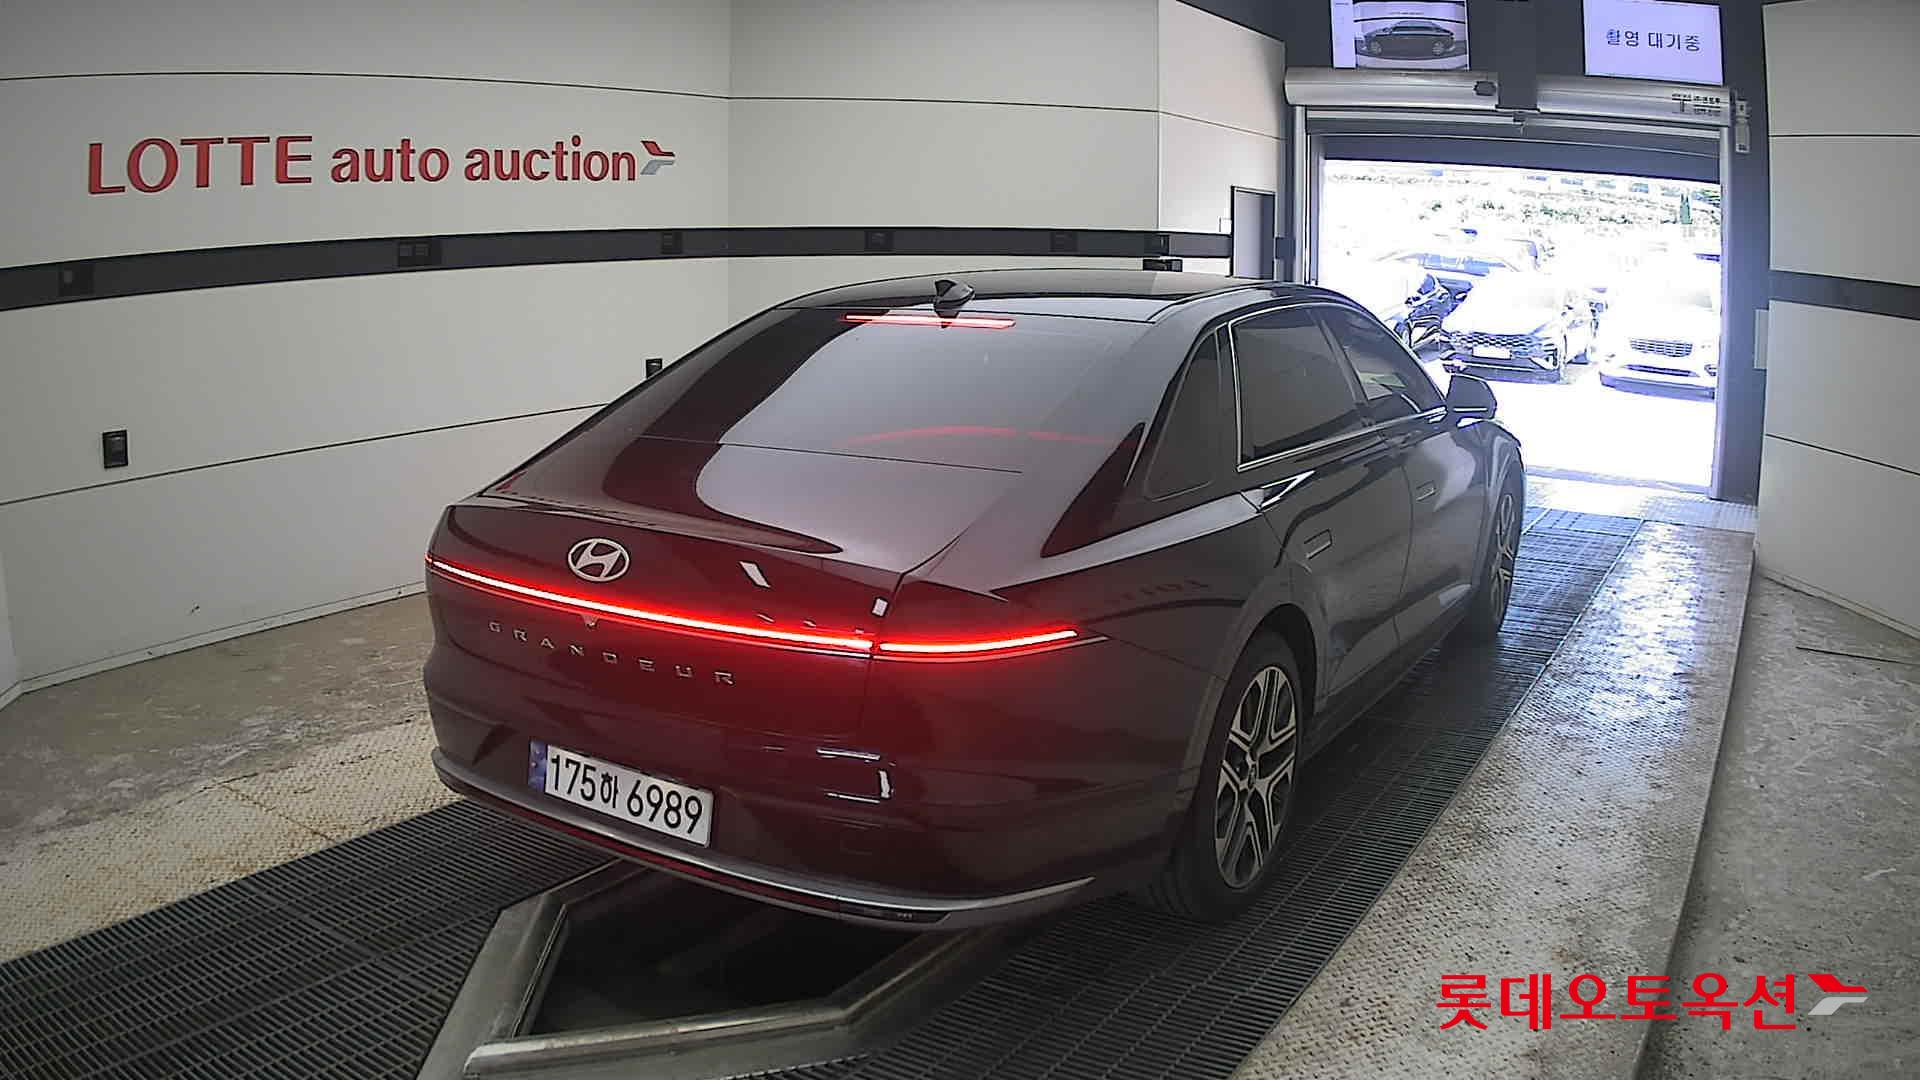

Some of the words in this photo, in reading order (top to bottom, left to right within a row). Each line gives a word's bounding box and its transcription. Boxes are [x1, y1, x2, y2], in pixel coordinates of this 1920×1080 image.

[1648, 32, 1700, 52] 대기중
[88, 136, 312, 194] LOTTE
[330, 138, 448, 182] auto
[464, 135, 637, 182] auction
[489, 621, 736, 686] GRANDEUR
[551, 754, 619, 809] 175하
[627, 780, 703, 834] 6989
